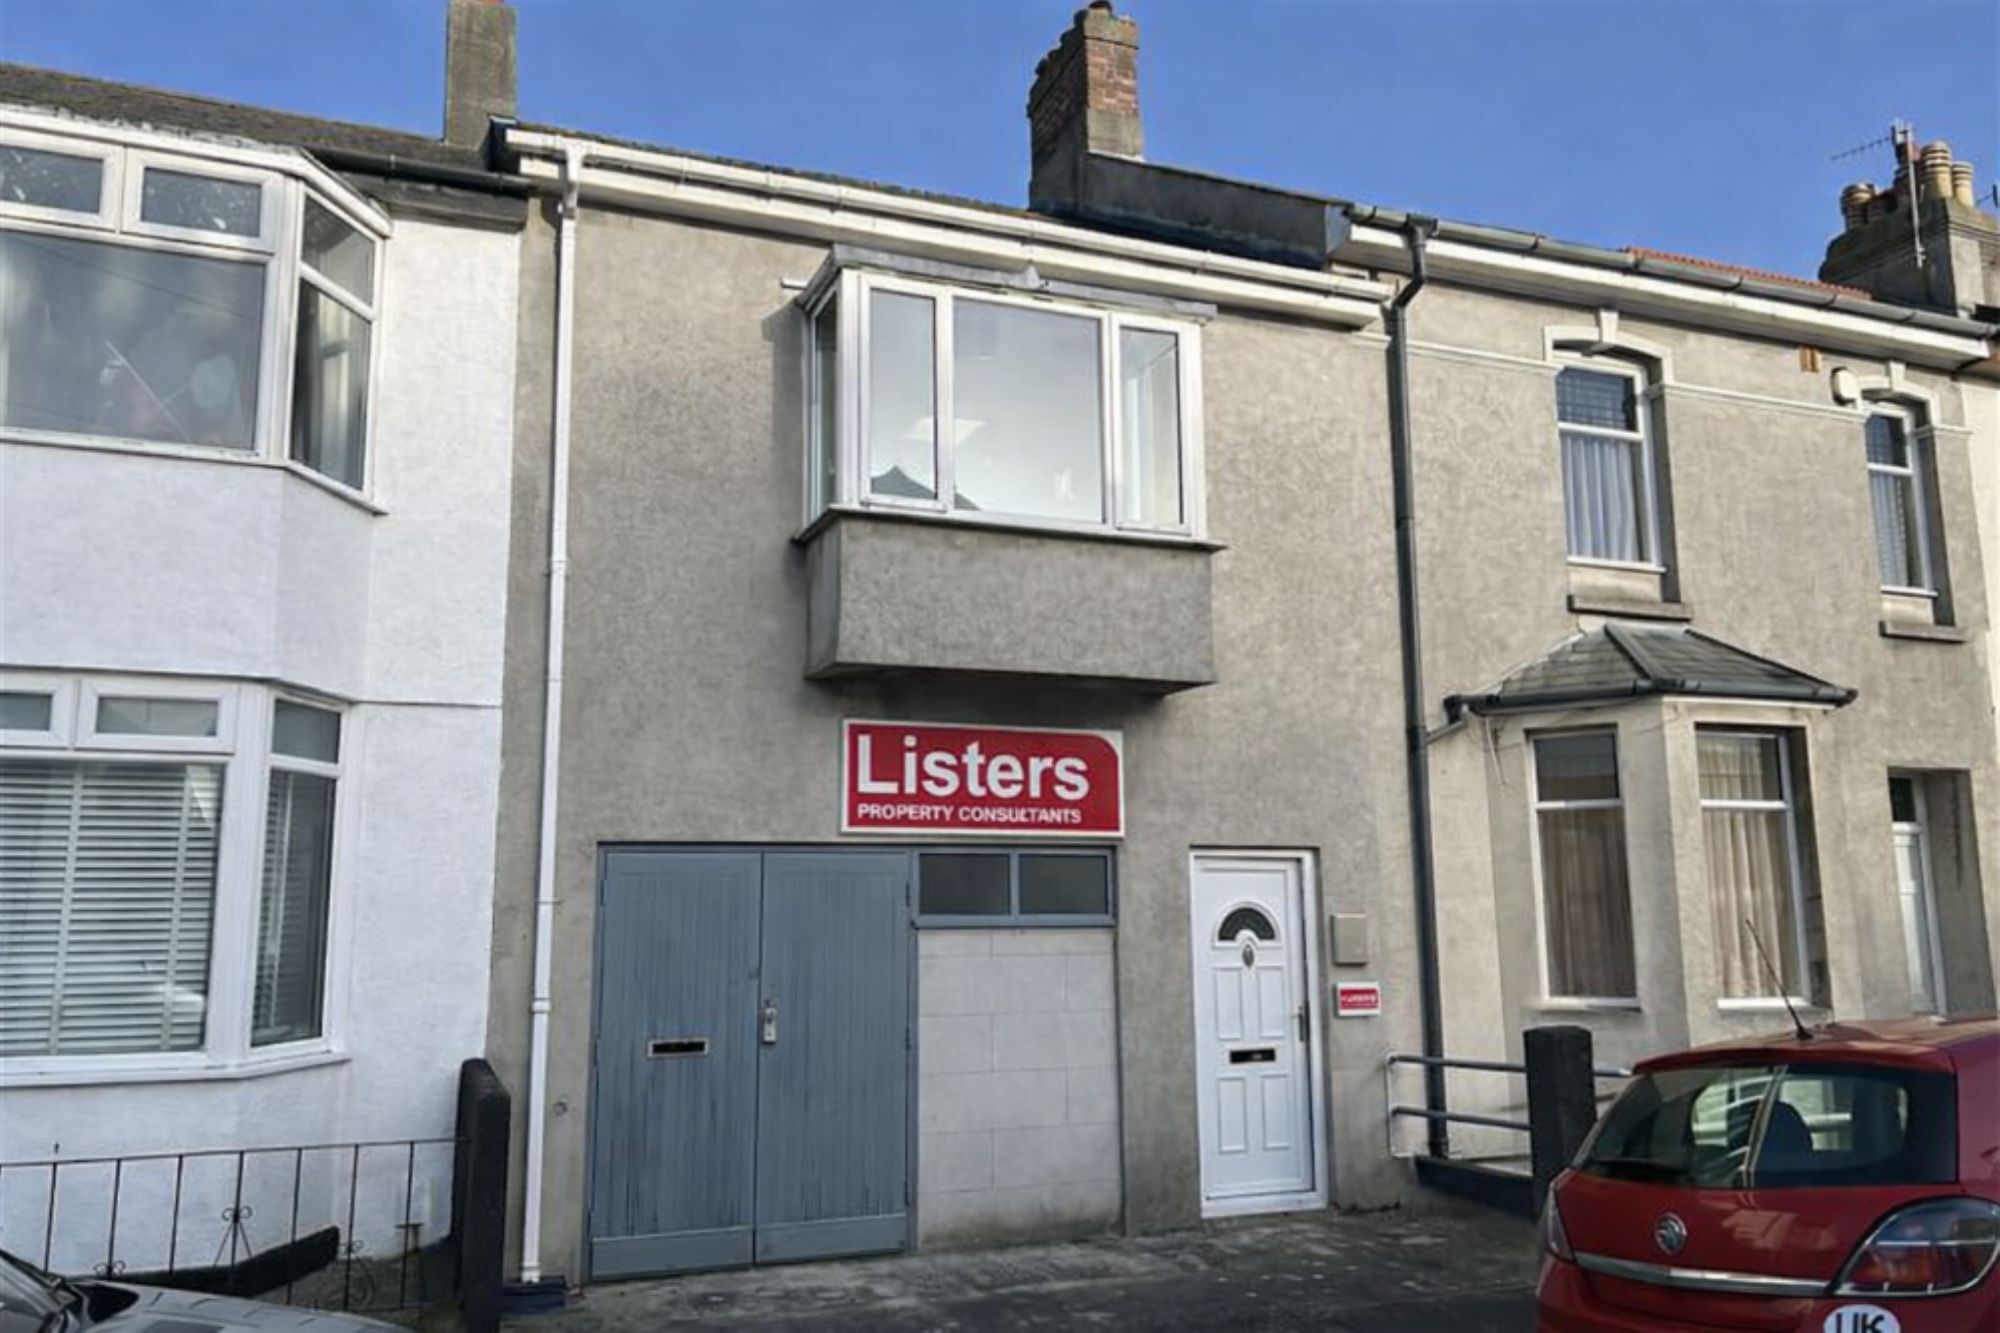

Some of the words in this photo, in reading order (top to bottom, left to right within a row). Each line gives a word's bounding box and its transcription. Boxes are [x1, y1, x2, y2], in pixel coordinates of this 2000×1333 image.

[857, 734, 1089, 800] Listers
[857, 803, 953, 821] PROPERTY
[959, 806, 1082, 824] CONSULTANTS
